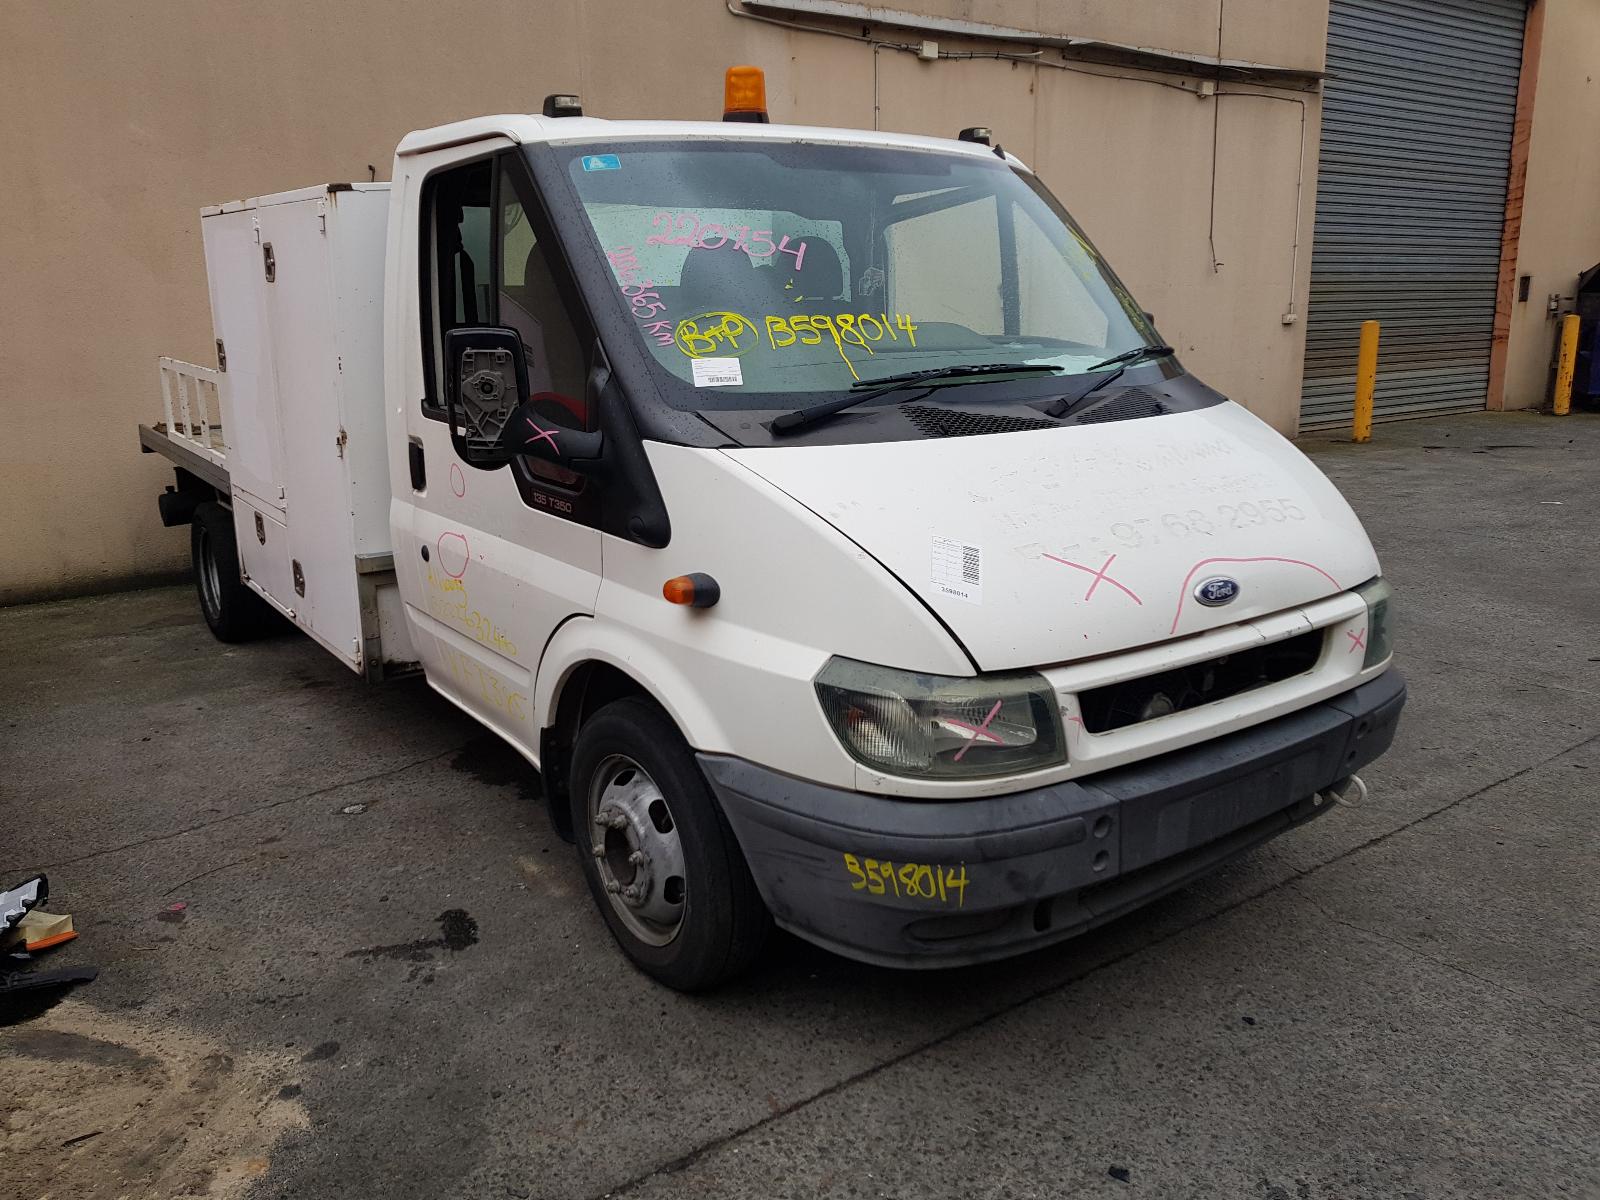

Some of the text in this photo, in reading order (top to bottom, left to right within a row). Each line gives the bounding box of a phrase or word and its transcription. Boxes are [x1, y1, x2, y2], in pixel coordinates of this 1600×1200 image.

[534, 492, 571, 512] 135 T350
[1208, 581, 1233, 599] Ford
